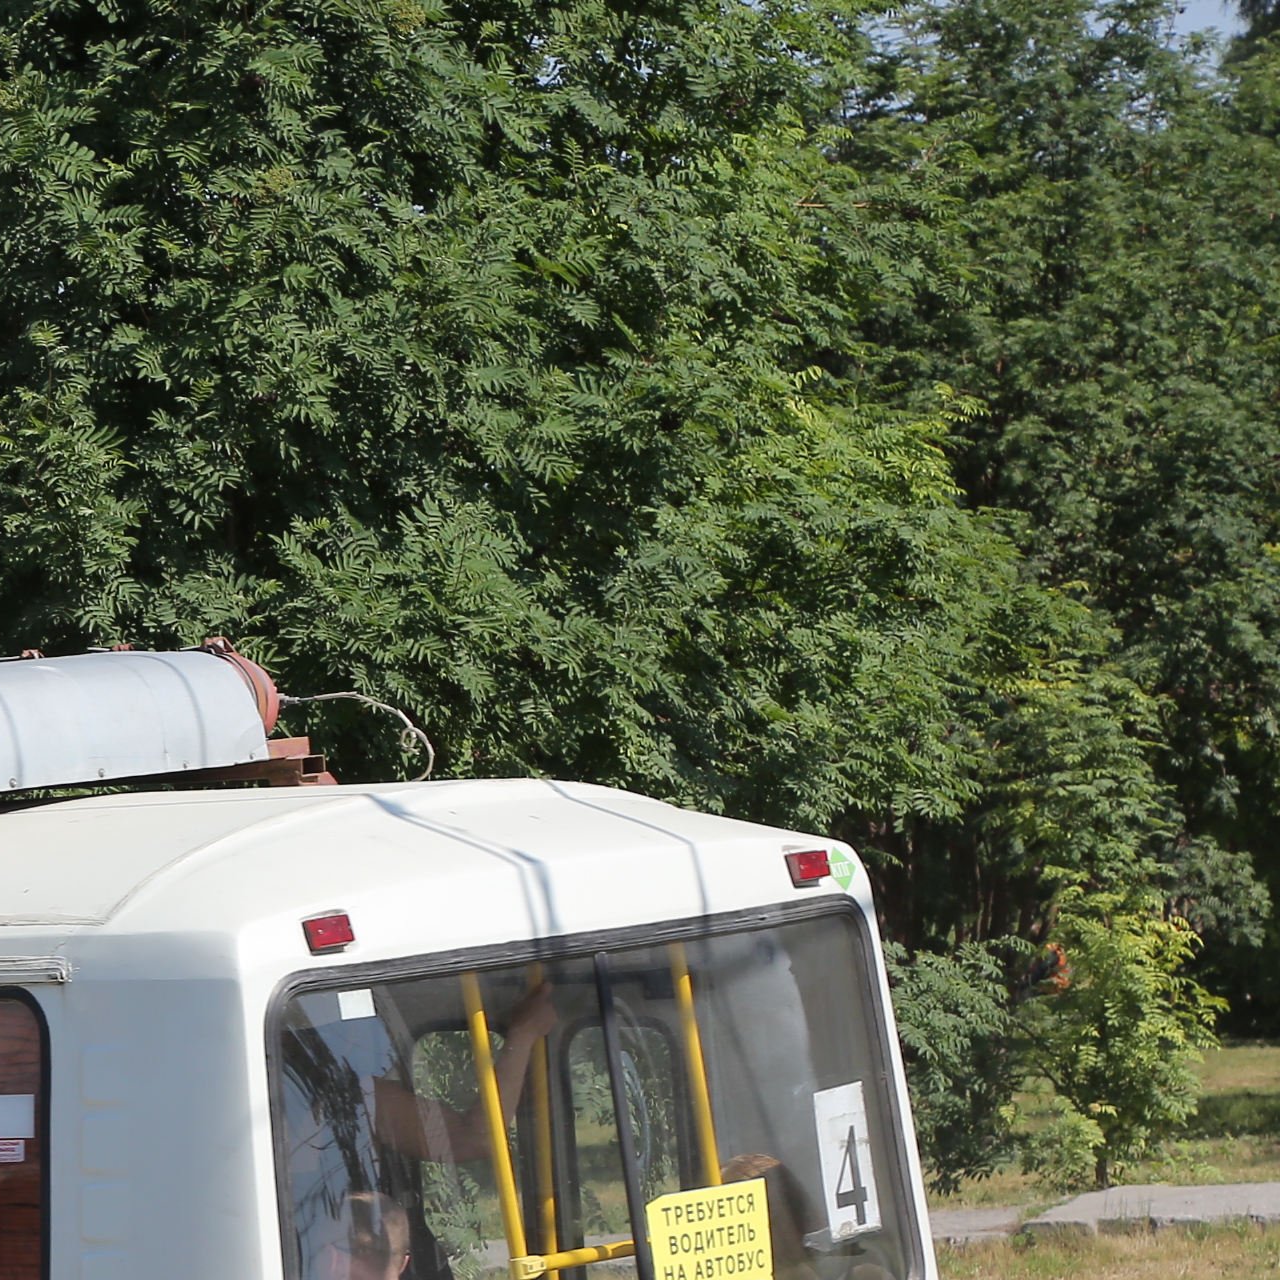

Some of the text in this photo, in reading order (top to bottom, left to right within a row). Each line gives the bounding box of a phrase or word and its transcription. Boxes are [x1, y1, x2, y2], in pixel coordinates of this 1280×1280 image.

[836, 1125, 868, 1226] 4
[661, 1193, 755, 1226] ТРЕБУЕТСЯ
[669, 1223, 756, 1255] ВОДИТЕЛЬ
[695, 1250, 765, 1280] АВТОБУС
